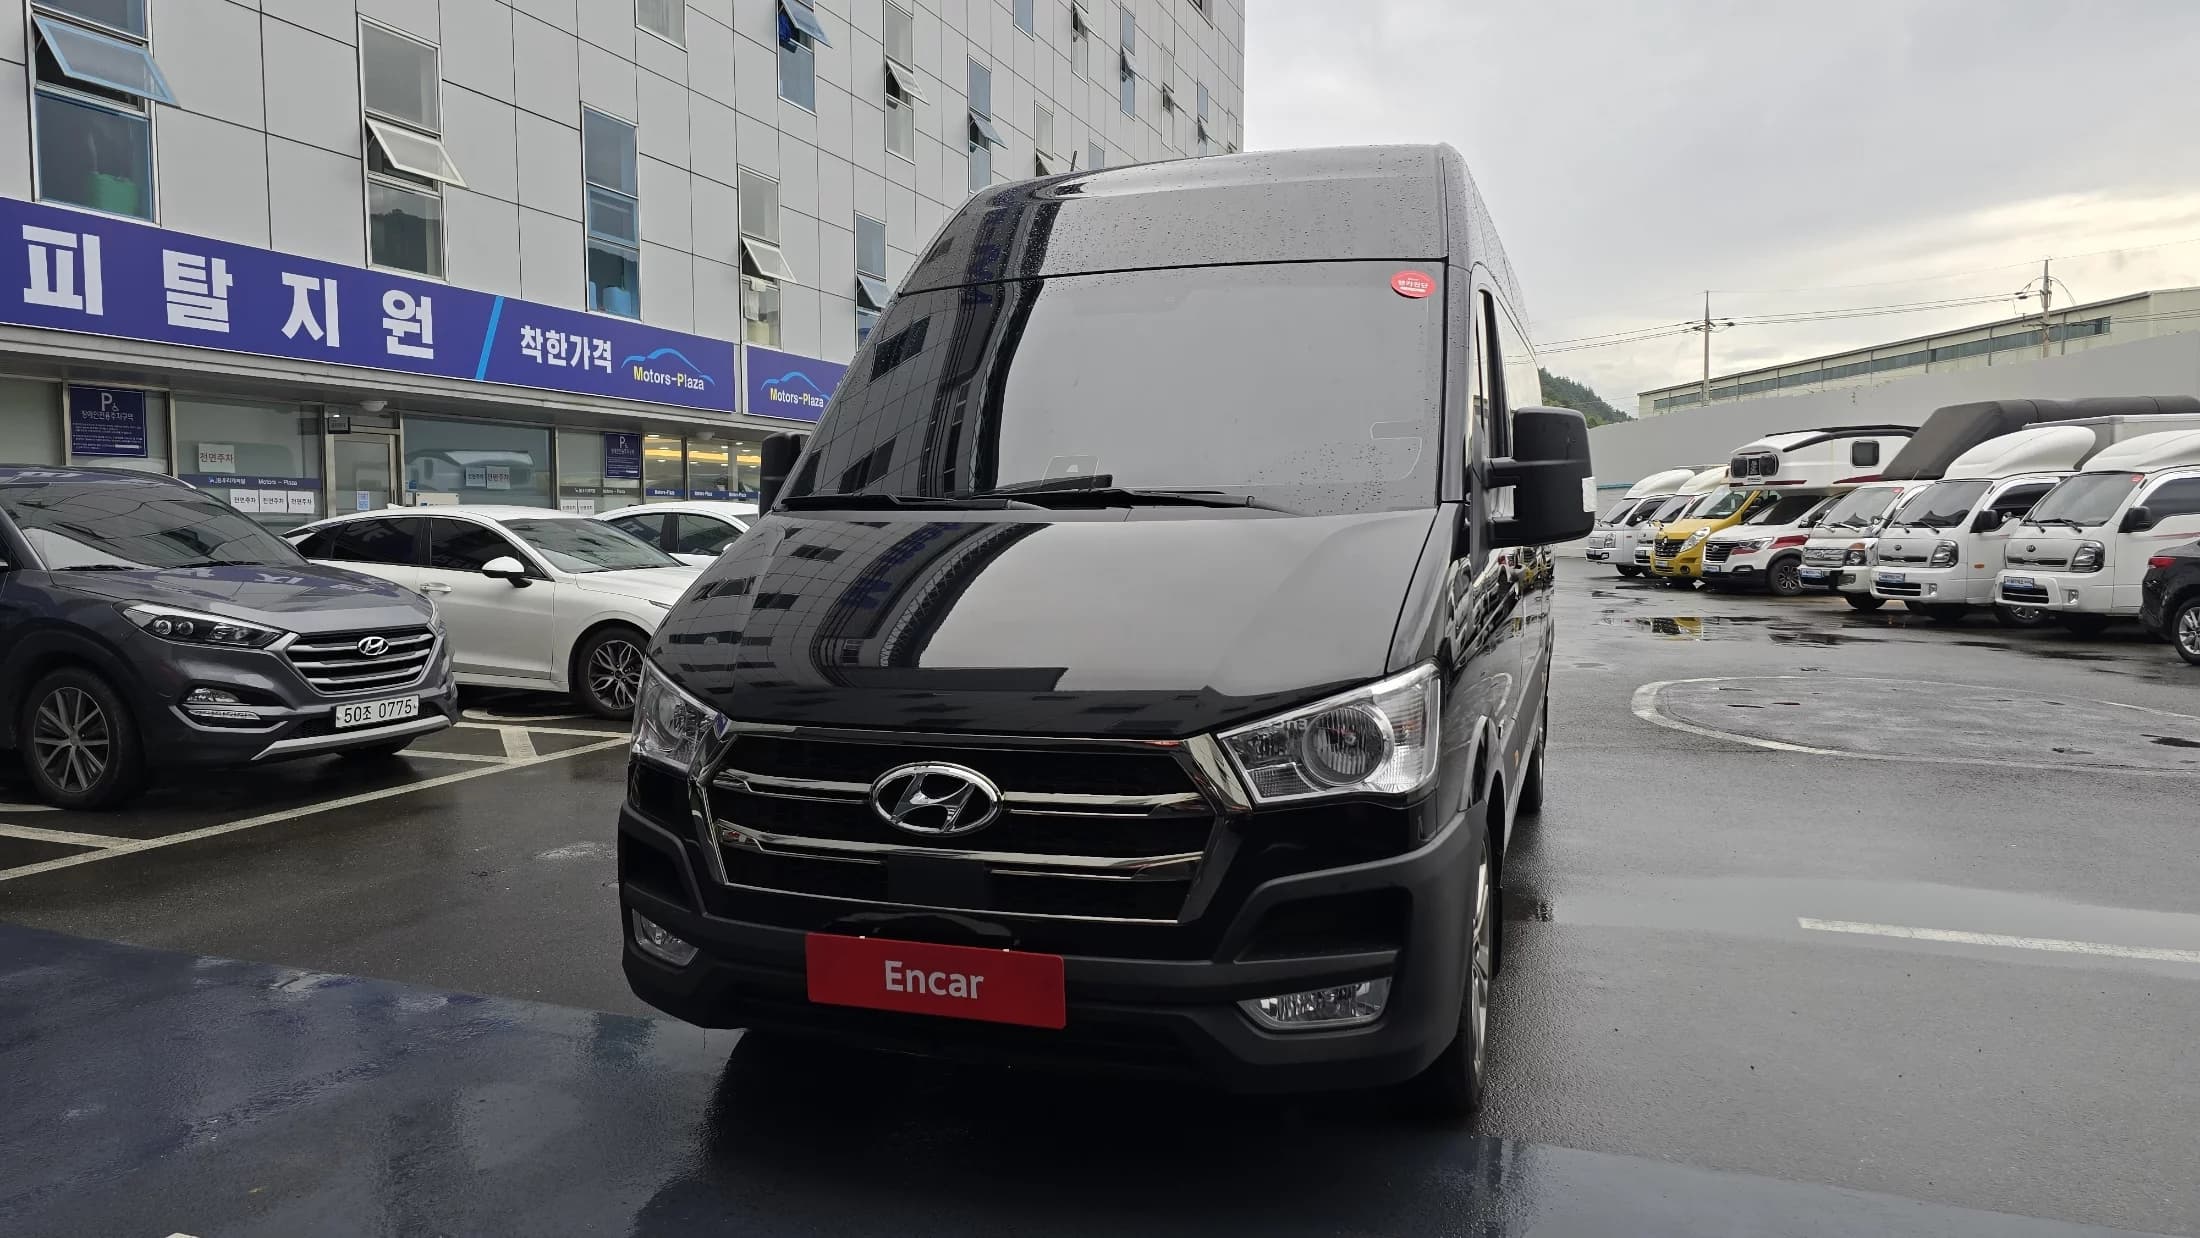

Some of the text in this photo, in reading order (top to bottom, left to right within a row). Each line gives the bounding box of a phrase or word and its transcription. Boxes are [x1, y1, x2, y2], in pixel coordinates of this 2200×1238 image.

[520, 324, 613, 374] 착한가격
[633, 365, 705, 391] Motors-Plaza
[101, 392, 113, 412] P
[770, 387, 824, 408] Motors-Plaza
[200, 452, 233, 463] 전면주차
[344, 699, 412, 723] 50조 0775
[884, 959, 985, 1000] Encar
